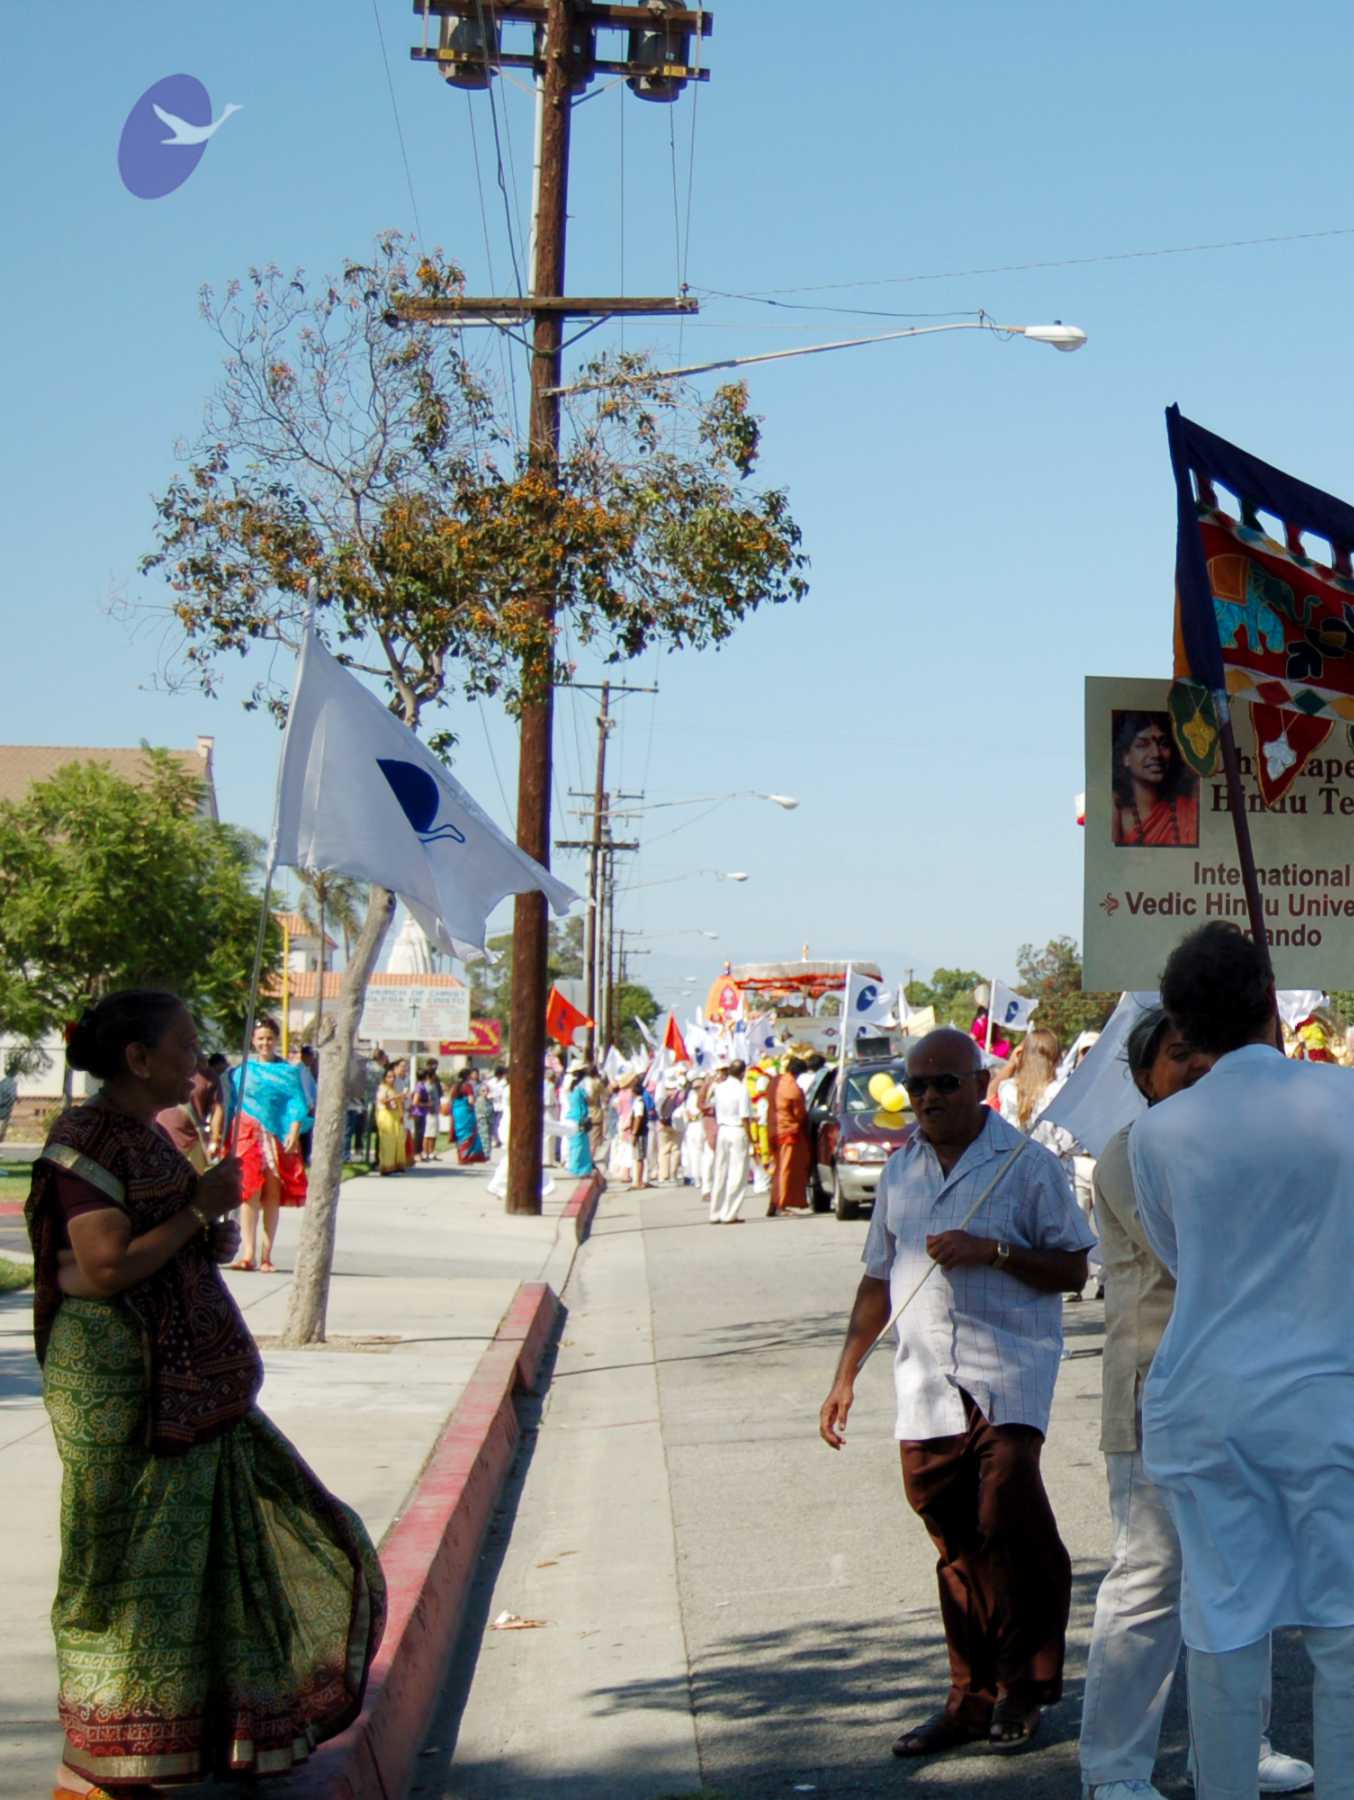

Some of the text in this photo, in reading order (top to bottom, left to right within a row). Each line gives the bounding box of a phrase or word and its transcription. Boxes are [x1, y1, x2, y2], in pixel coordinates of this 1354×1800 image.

[1193, 862, 1351, 887] Intenational
[1125, 892, 1197, 916] Vedic
[1205, 893, 1280, 917] Hinu
